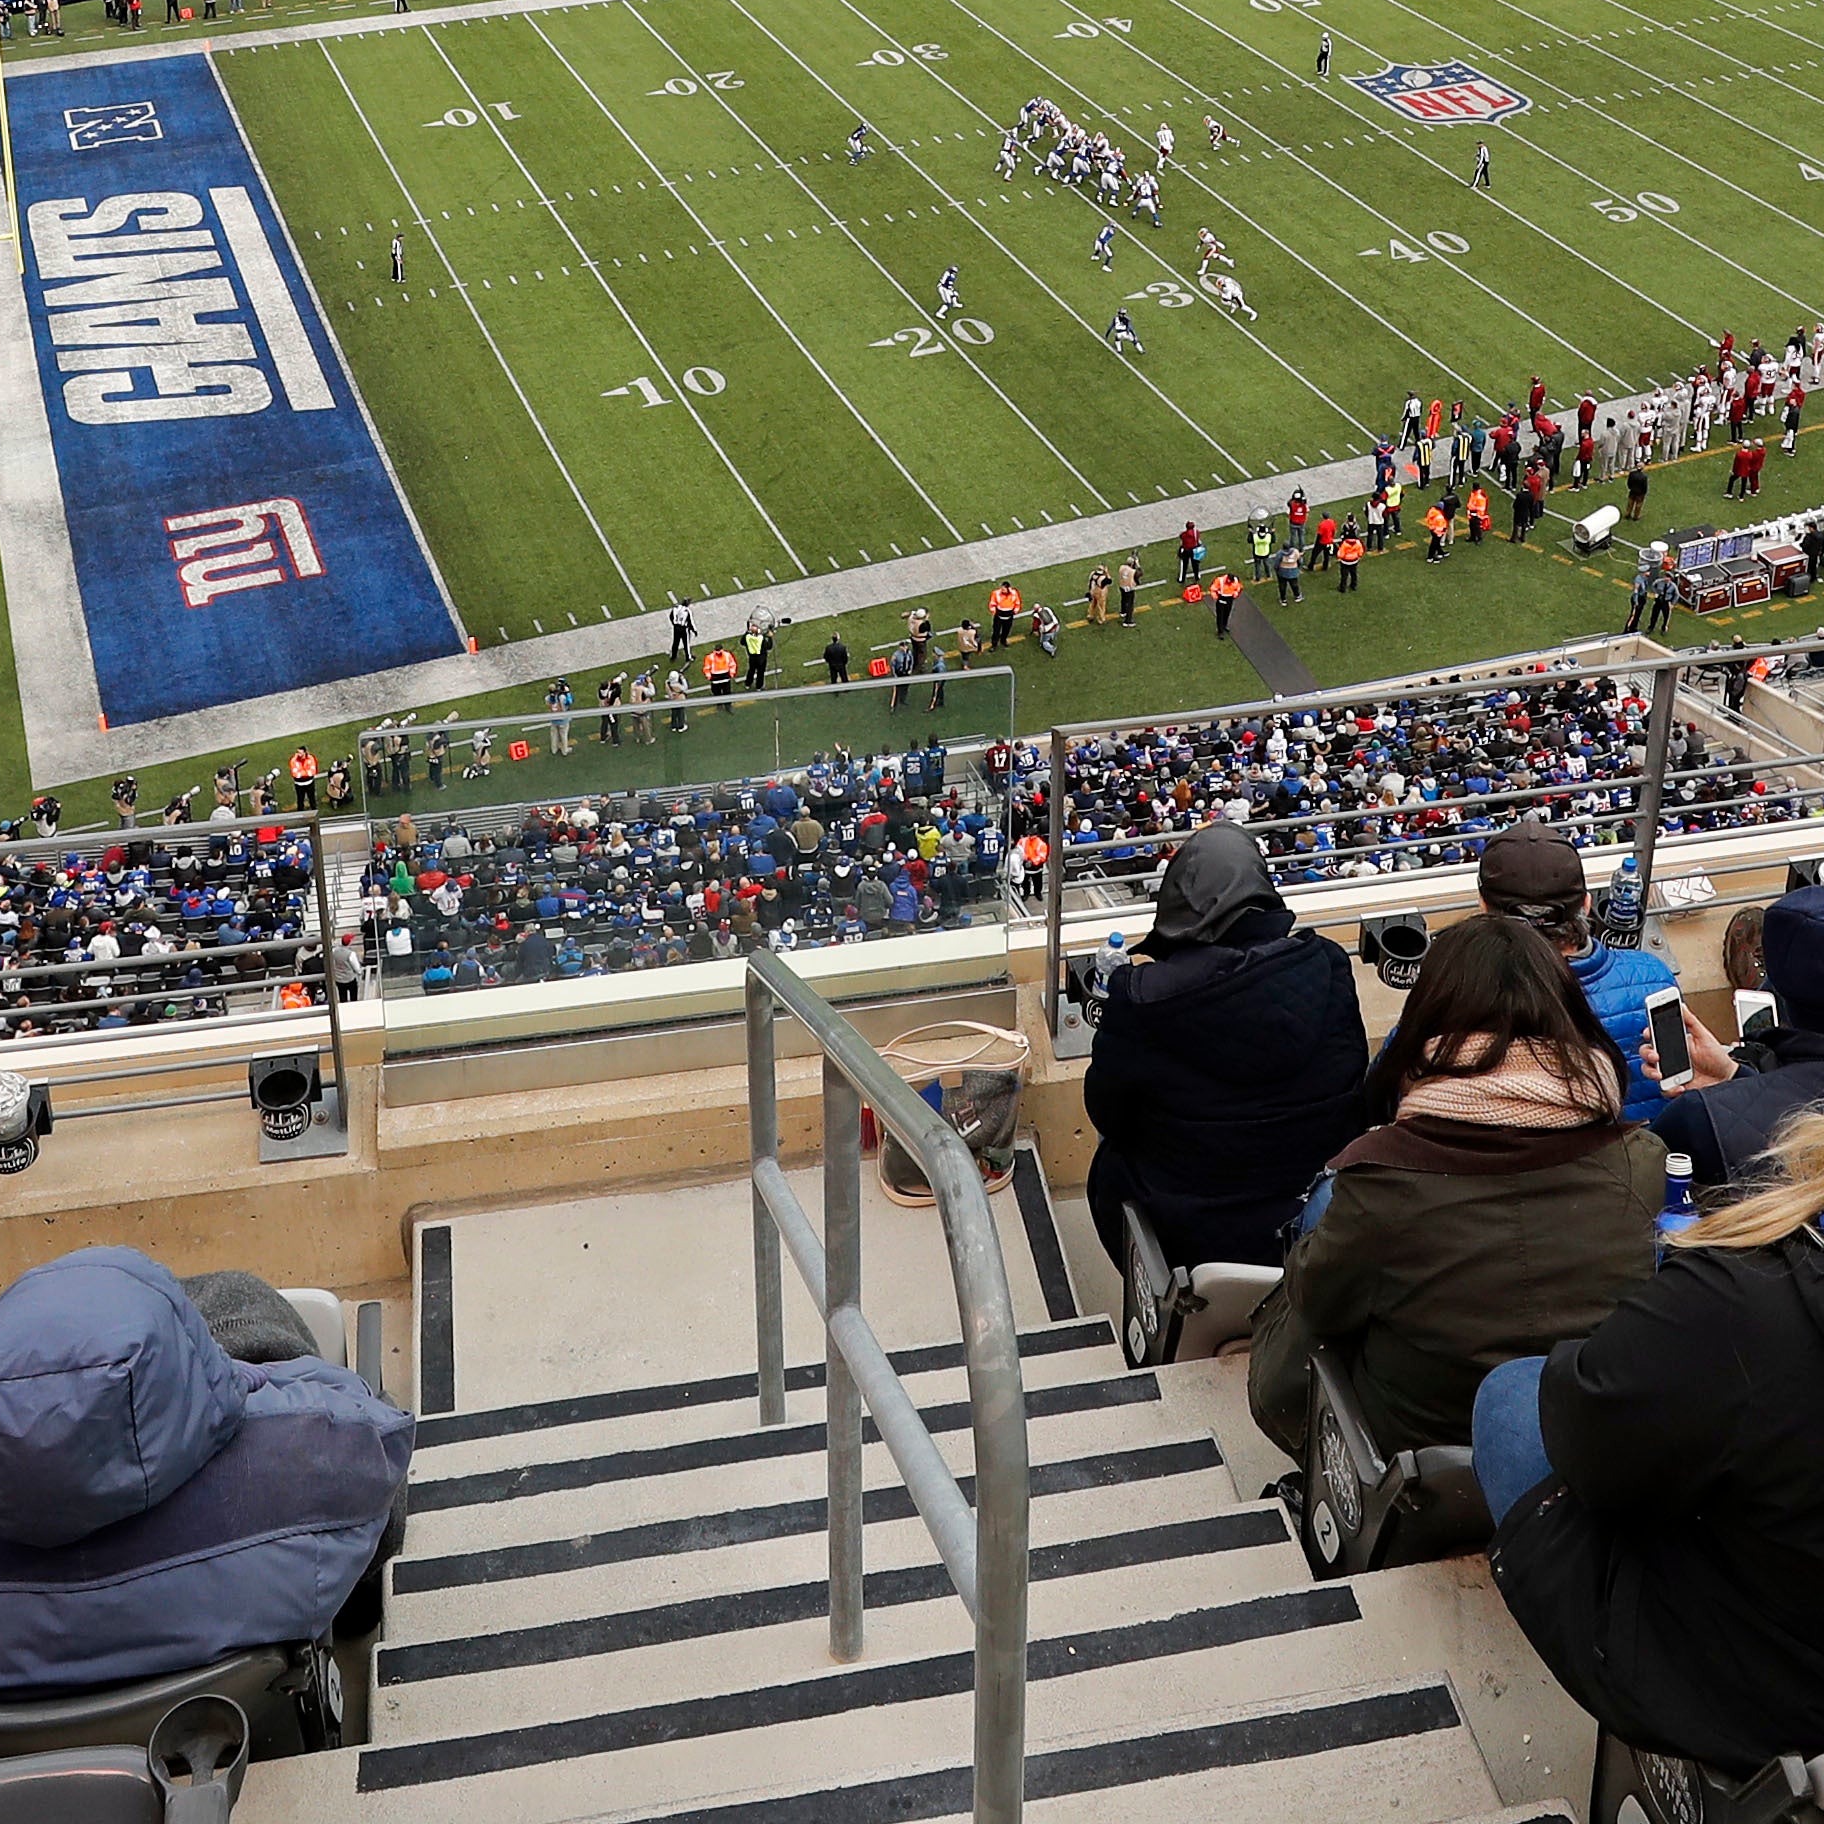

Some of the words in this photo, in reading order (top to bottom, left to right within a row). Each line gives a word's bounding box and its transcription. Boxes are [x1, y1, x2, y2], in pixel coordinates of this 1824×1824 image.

[1068, 16, 1134, 40] 40
[874, 43, 947, 68] 30
[665, 69, 745, 96] 20
[1391, 84, 1514, 117] NFL
[444, 101, 521, 129] 10
[1591, 190, 1680, 224] 50
[1388, 230, 1471, 264] 40
[27, 188, 276, 424] GIANTS
[893, 317, 994, 358] 20
[628, 367, 726, 408] 10
[874, 660, 886, 675] 10
[513, 743, 525, 758] G
[993, 750, 1007, 763] 17
[741, 798, 754, 810] 10
[842, 830, 854, 841] 10
[983, 840, 998, 853] 10
[267, 1121, 303, 1136] MetLife
[1321, 1521, 1332, 1545] 2
